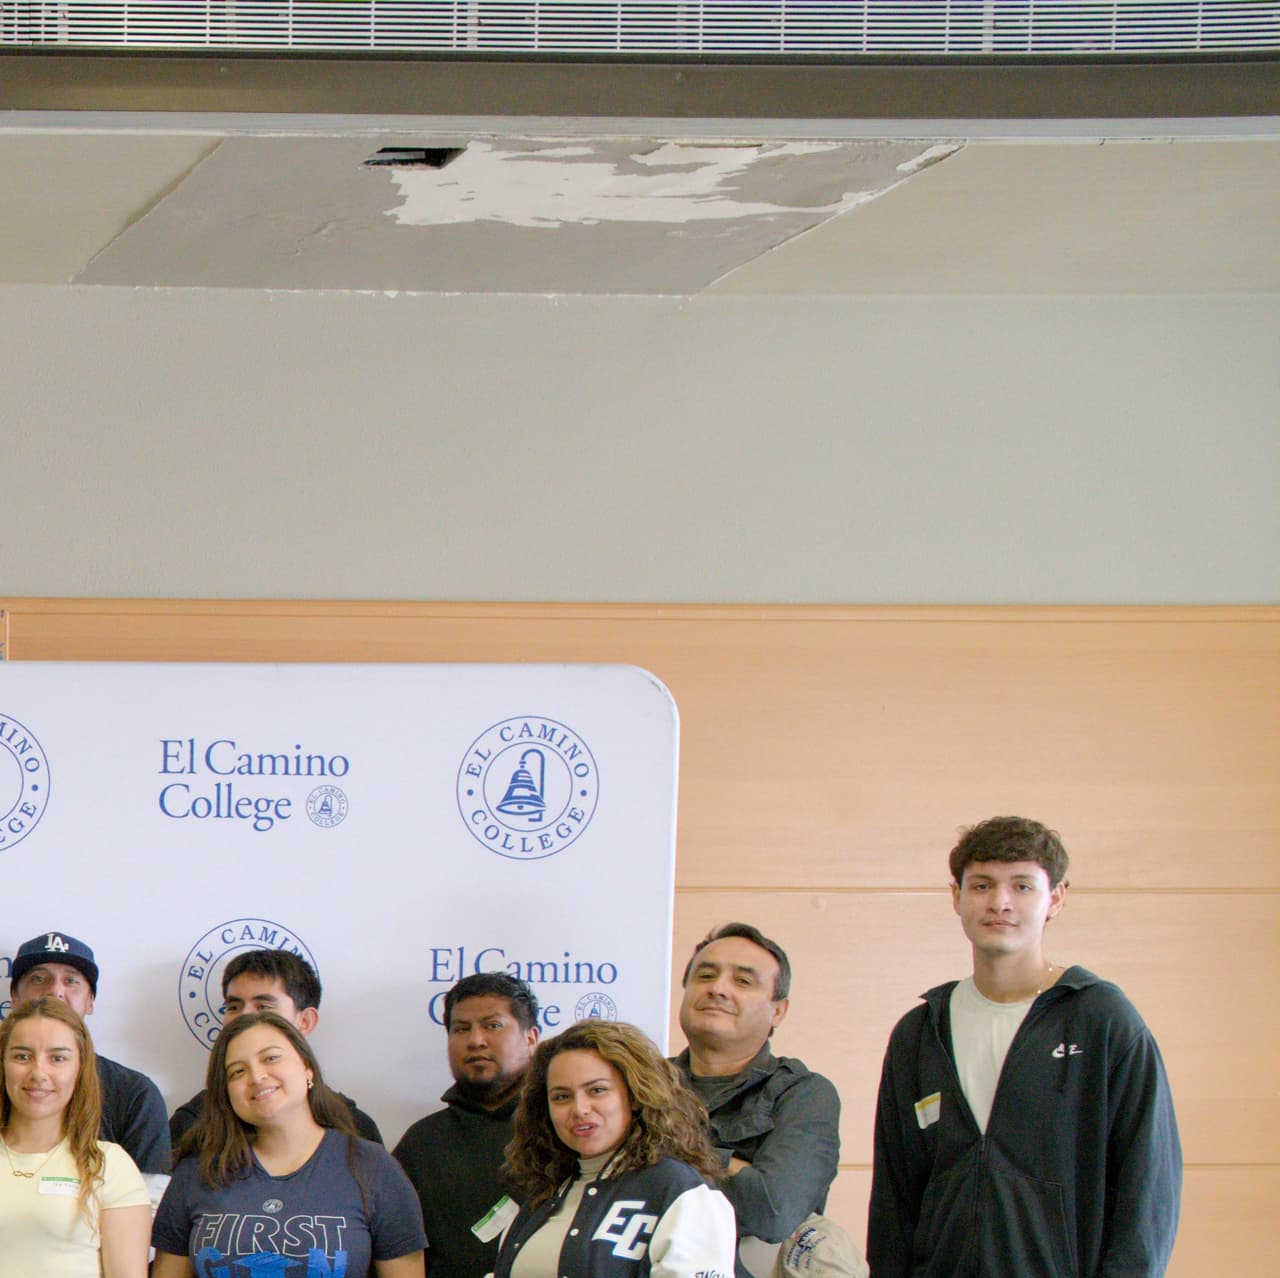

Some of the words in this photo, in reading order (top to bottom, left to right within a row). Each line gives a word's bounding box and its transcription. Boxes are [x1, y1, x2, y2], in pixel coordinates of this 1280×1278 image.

[158, 738, 197, 775] El
[204, 740, 350, 779] Camino
[466, 749, 491, 778] EL
[500, 723, 589, 778] CAMINO
[159, 782, 293, 832] College
[472, 807, 584, 852] COLLEGE
[44, 933, 69, 953] LA
[188, 950, 213, 980] EL
[221, 925, 304, 957] CAMI
[428, 946, 464, 982] El
[194, 1213, 347, 1259] FIRST
[592, 1200, 659, 1261] EC
